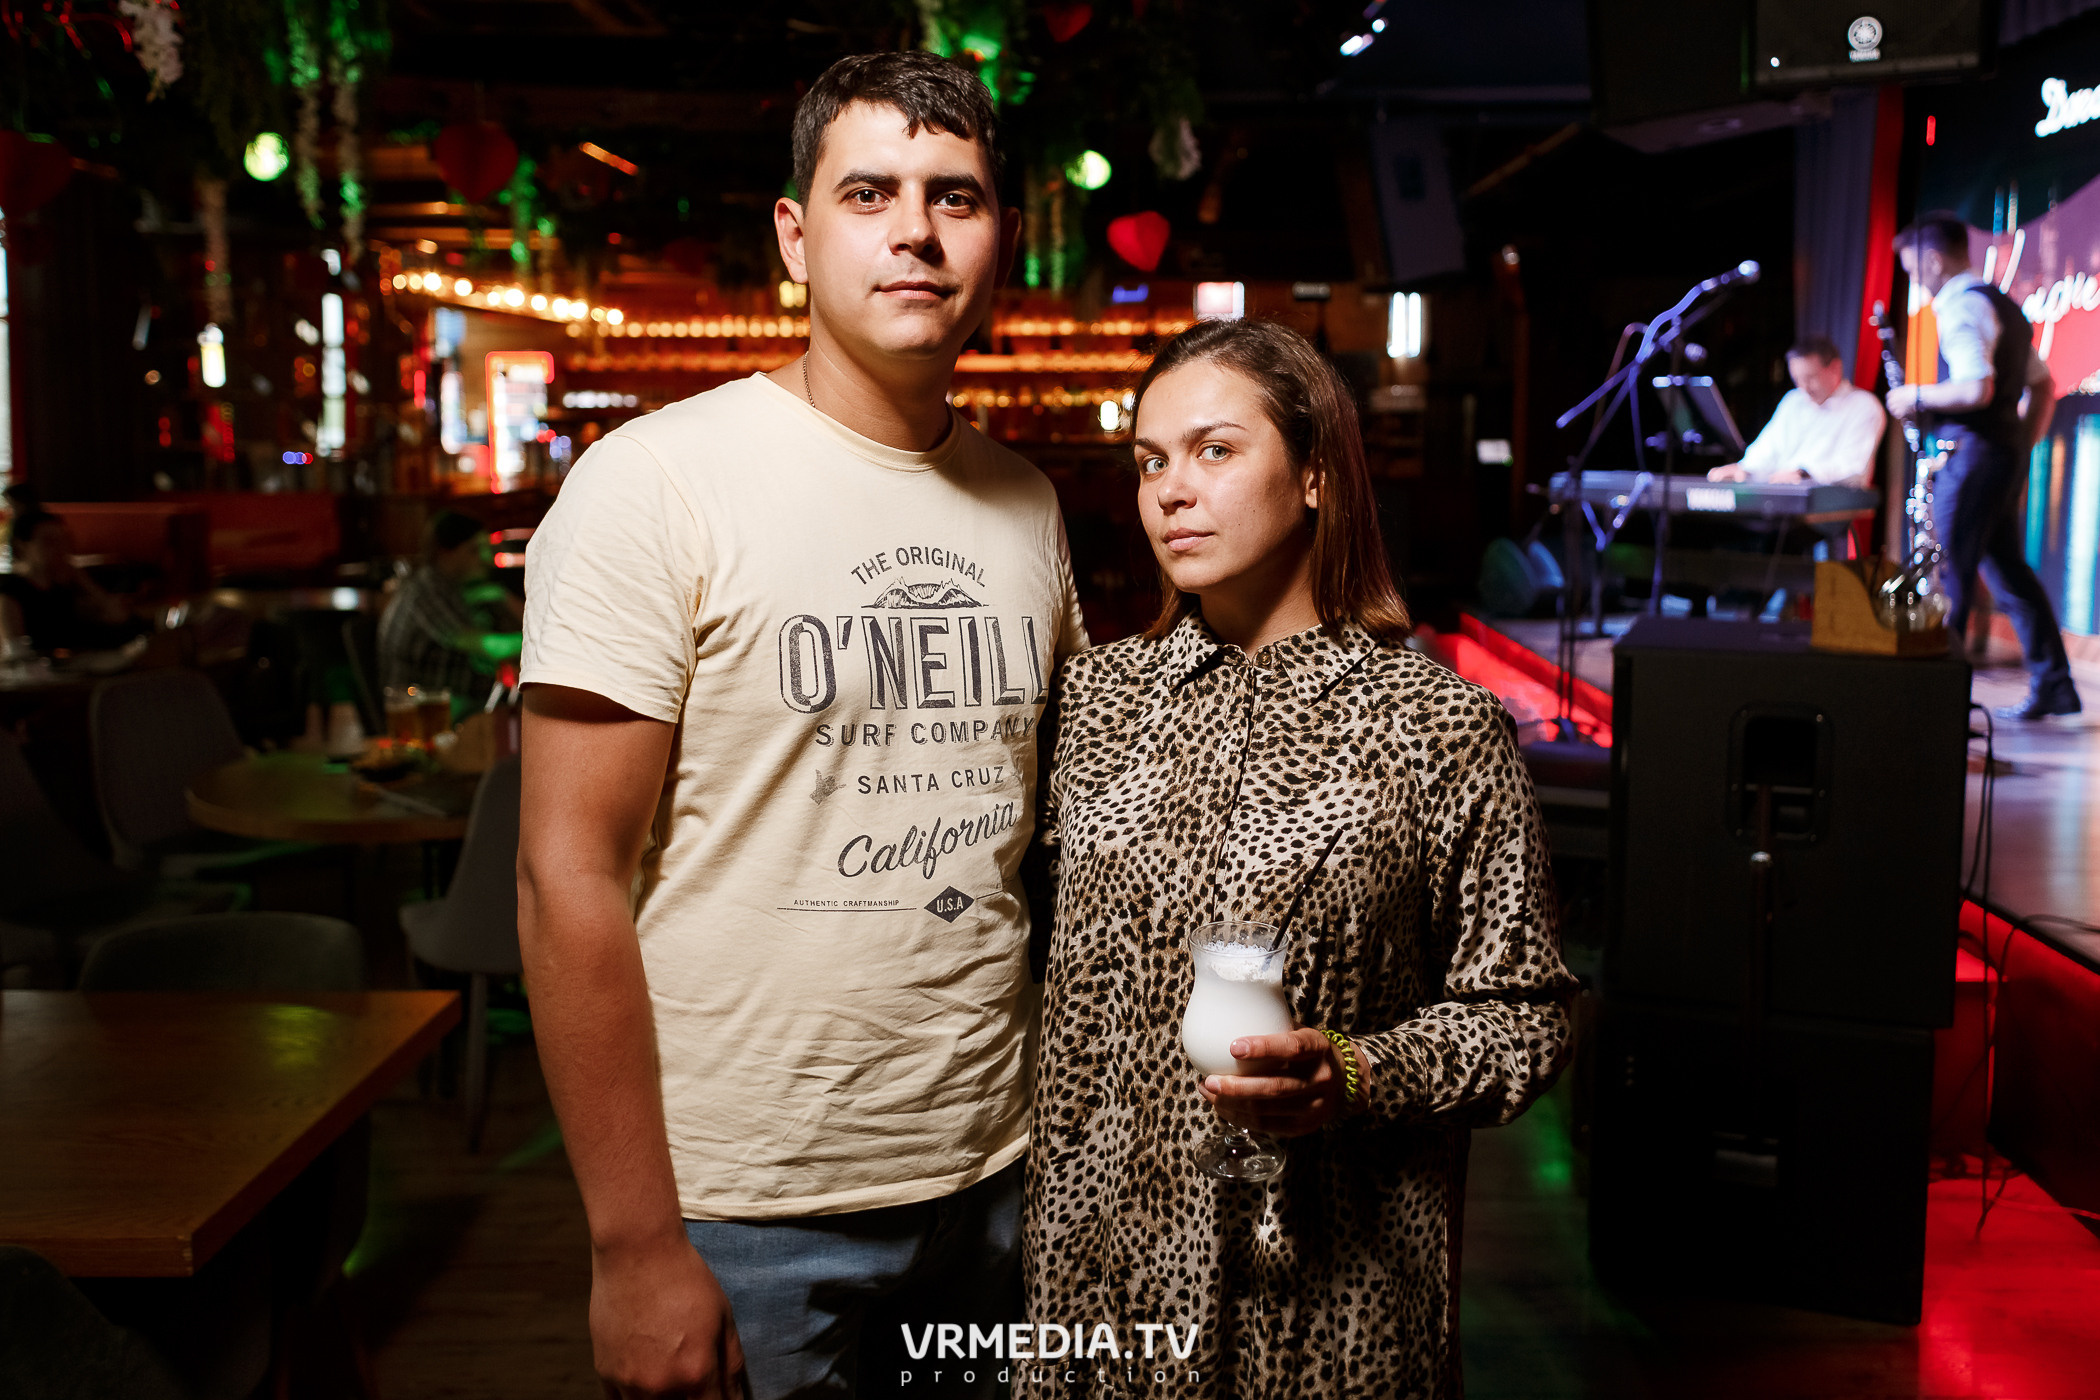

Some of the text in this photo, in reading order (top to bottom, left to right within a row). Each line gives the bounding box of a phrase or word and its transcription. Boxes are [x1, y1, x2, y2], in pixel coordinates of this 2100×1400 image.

[850, 546, 986, 588] THE ORIGINAL
[815, 717, 1035, 748] SURF COMPANY
[857, 766, 1004, 794] SANTA CRUZ
[837, 801, 1019, 880] California
[793, 899, 900, 907] AUTHENTIC CRAFTMANSHIP
[936, 896, 964, 913] U.S.A
